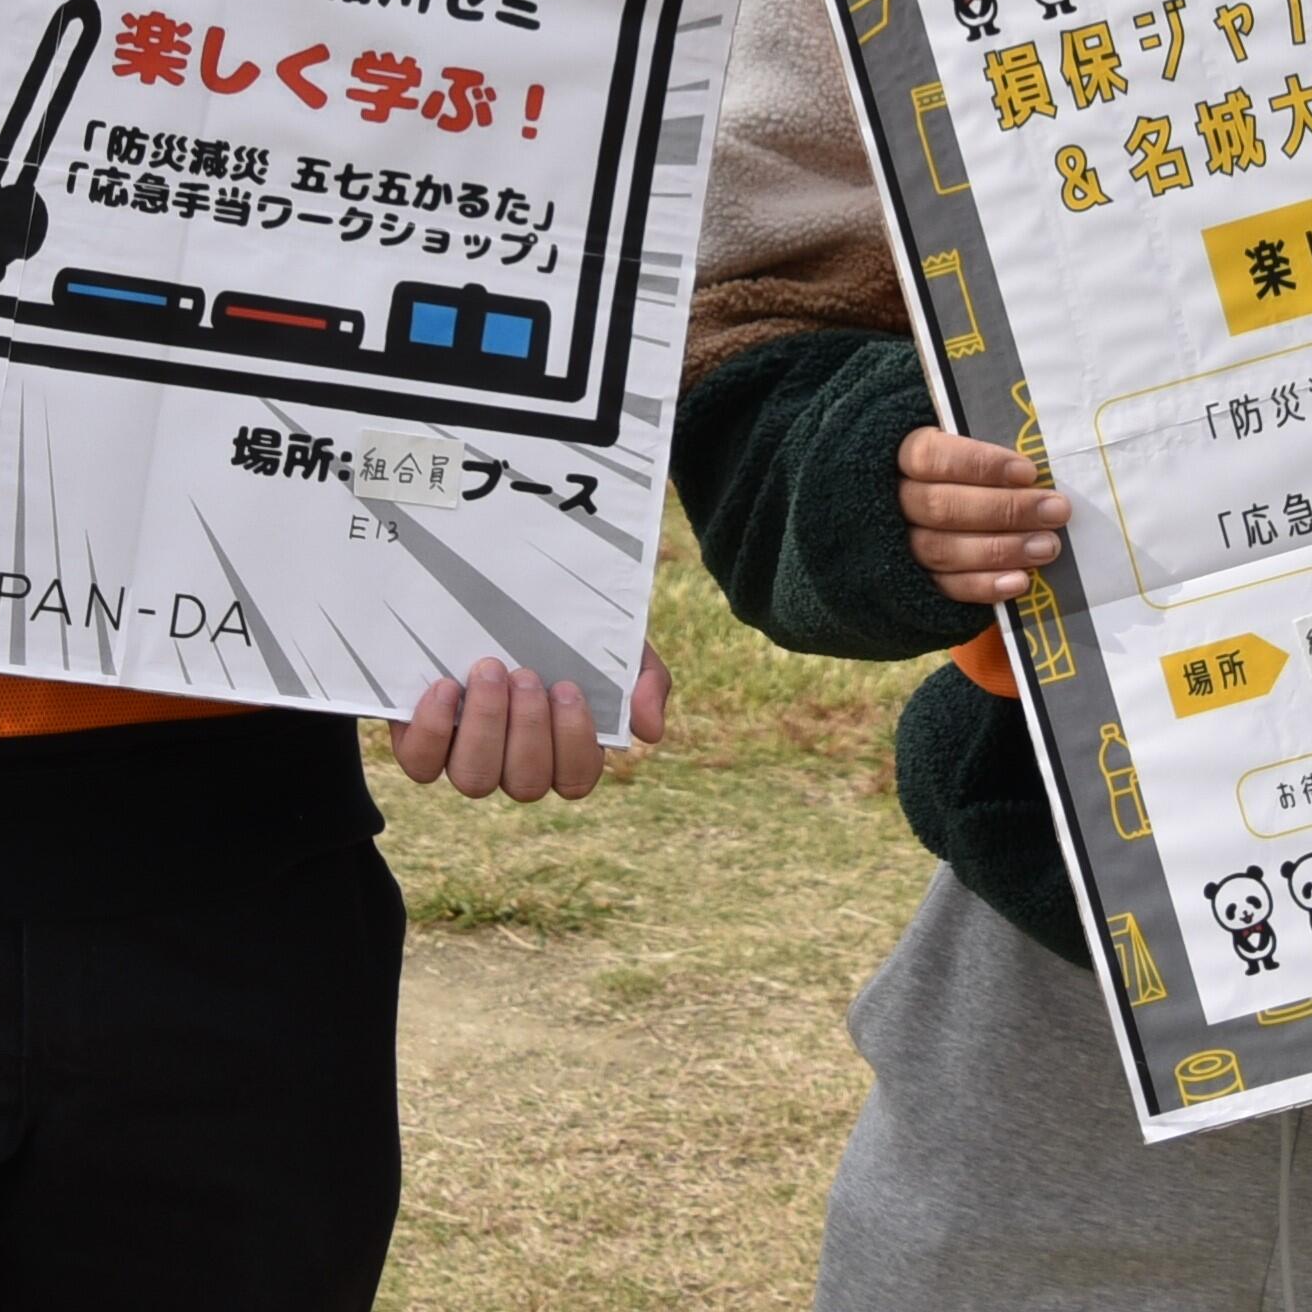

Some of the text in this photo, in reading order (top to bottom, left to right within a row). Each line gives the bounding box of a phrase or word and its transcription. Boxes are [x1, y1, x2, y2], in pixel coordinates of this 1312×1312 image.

[112, 10, 545, 139] 楽しく学ぶ！
[82, 119, 556, 232] 「防災減災 五七五かるた」
[66, 160, 559, 274] 「応急手当ワークショップ」
[359, 447, 450, 494] 組合員
[461, 459, 599, 516] ブース
[348, 514, 400, 543] E13
[1182, 649, 1249, 697] 場所
